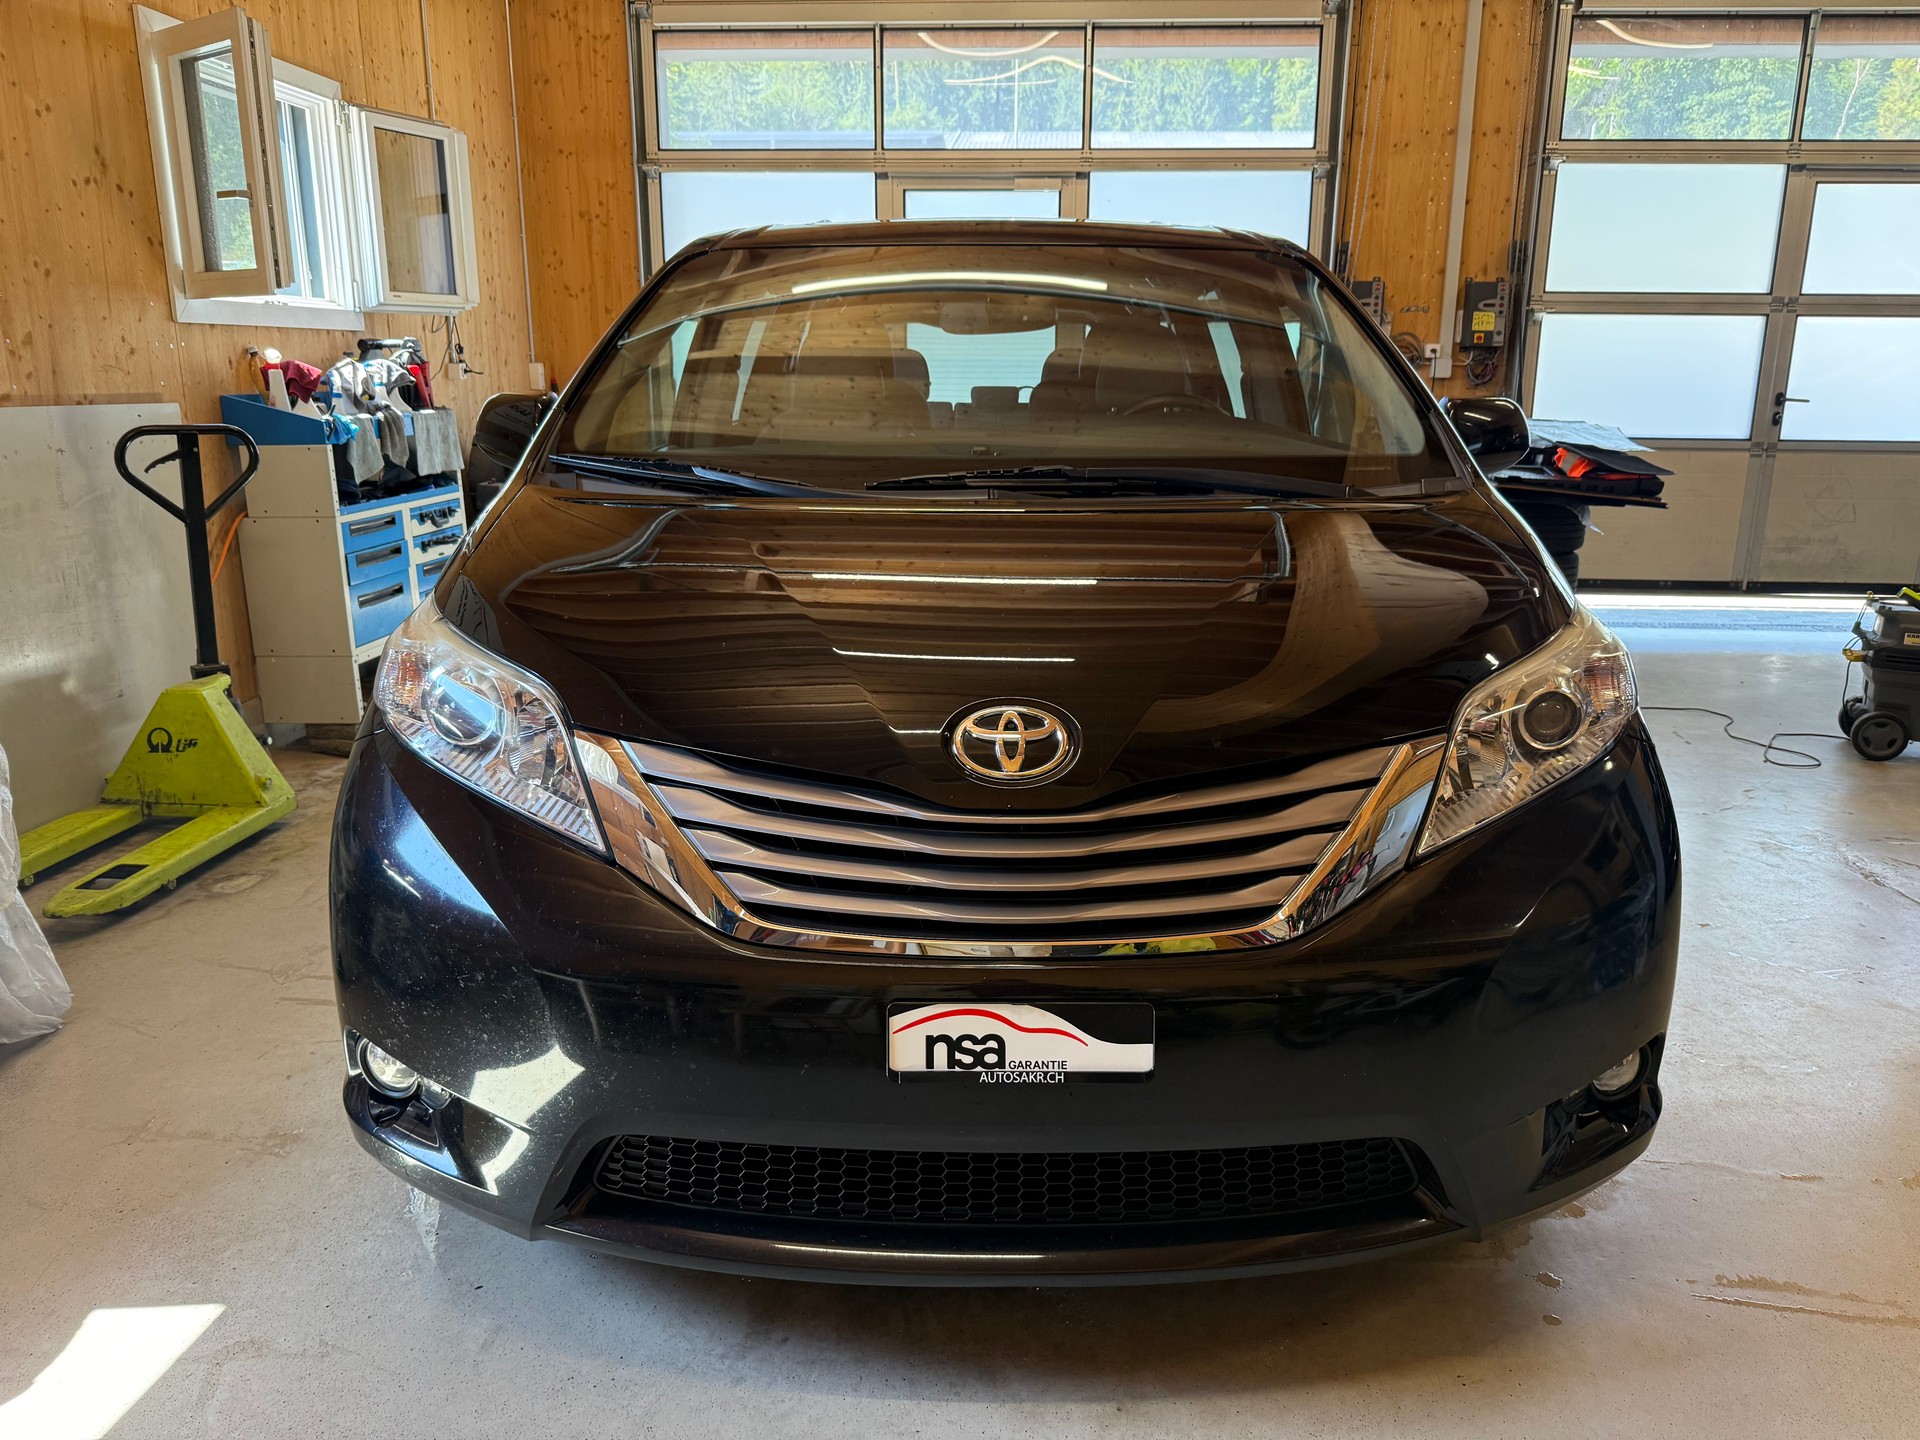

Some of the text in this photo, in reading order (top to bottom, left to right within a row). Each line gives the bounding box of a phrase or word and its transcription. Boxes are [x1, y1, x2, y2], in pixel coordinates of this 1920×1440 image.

[925, 1033, 1068, 1070] nsa GARANTIE
[979, 1072, 1065, 1083] AUTOSAKR.CH
